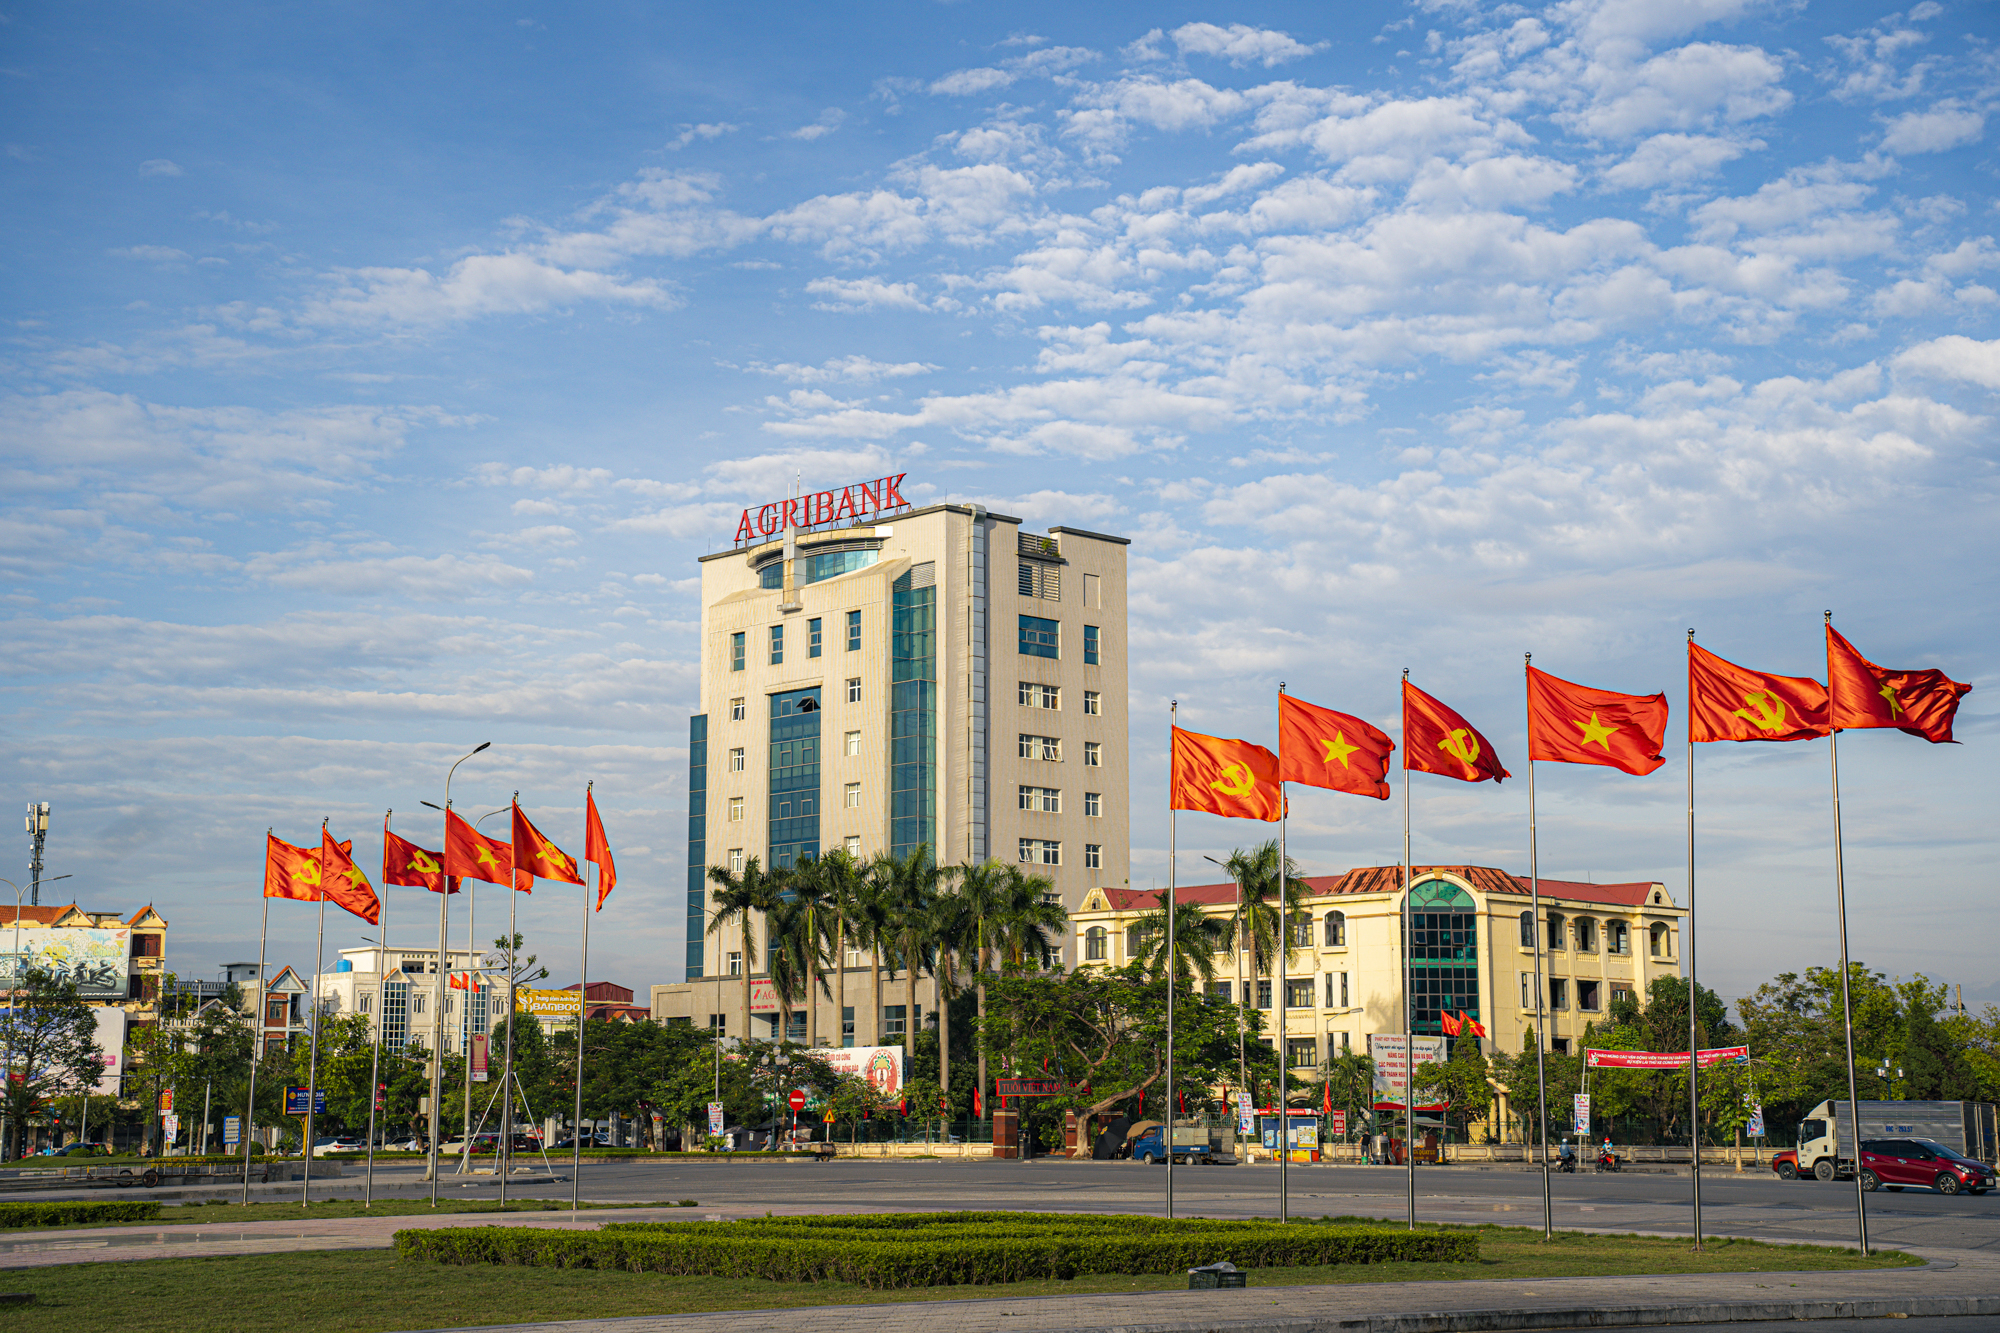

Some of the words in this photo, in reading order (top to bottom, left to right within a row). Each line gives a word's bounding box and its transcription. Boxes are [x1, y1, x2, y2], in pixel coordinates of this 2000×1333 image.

[734, 473, 910, 542] AGRIBANK
[533, 1003, 580, 1011] BAMBOO
[1042, 1082, 1061, 1093] NAM
